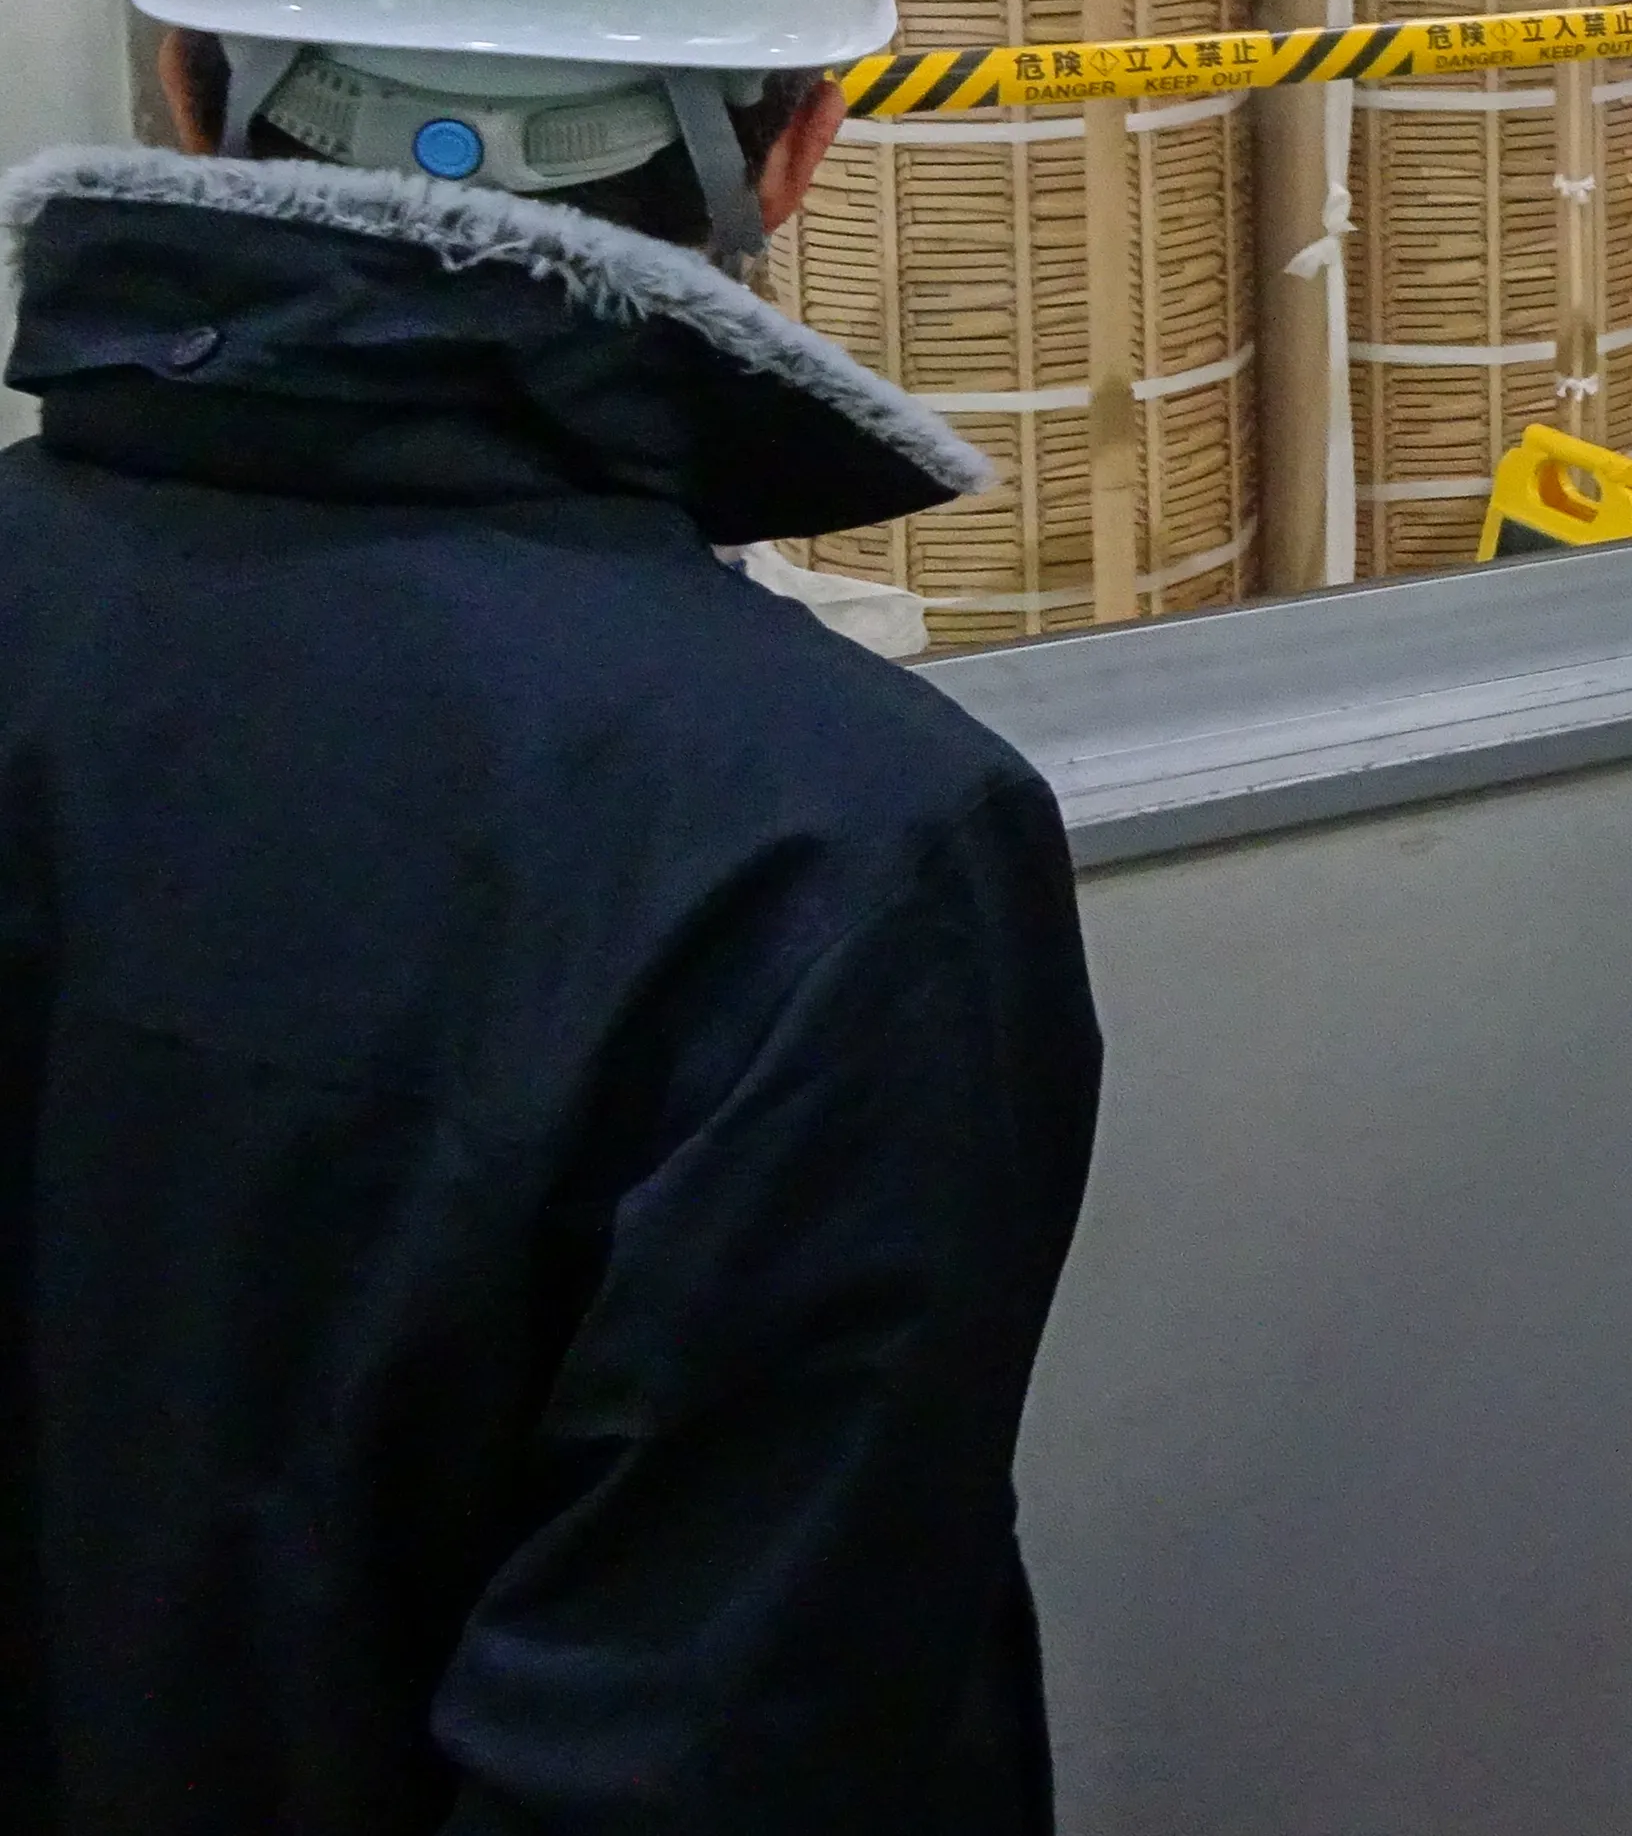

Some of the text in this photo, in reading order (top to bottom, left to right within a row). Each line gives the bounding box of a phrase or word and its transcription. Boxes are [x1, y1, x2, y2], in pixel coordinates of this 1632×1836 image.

[1426, 21, 1486, 51] 危険
[1014, 37, 1259, 81] 危険 立入禁止
[1435, 49, 1513, 69] DANGER
[1539, 42, 1587, 61] KEEP
[1024, 69, 1254, 102] DANGER KEEP OUT
